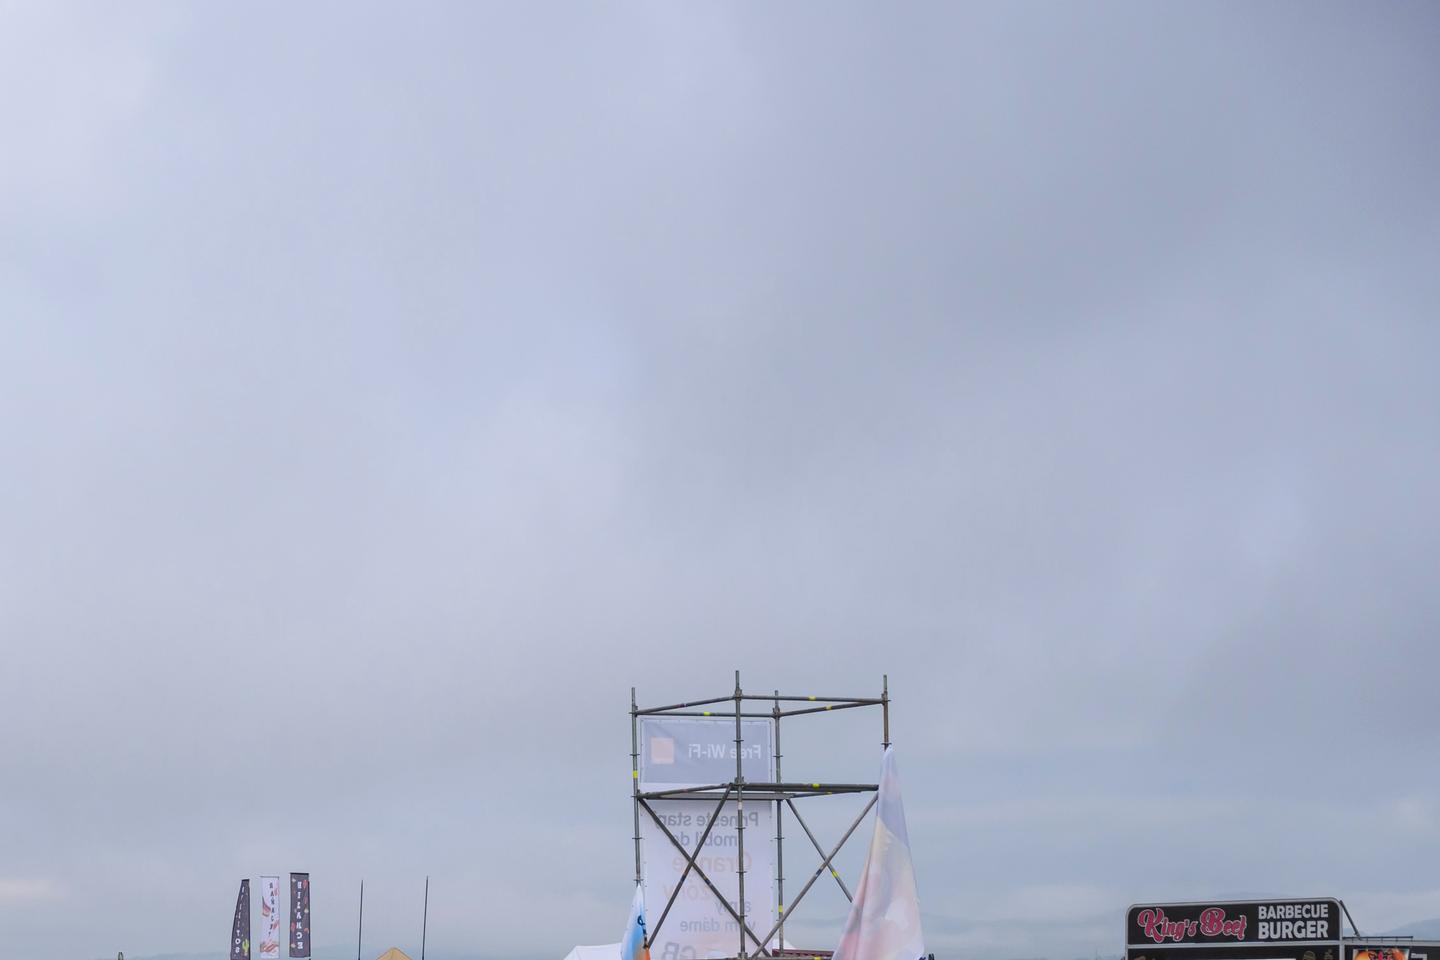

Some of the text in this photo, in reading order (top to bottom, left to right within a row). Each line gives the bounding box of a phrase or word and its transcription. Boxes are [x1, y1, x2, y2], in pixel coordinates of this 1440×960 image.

[1258, 904, 1328, 919] BARBECUE
[1137, 907, 1247, 943] King's Beef
[1258, 920, 1328, 940] BURGER
